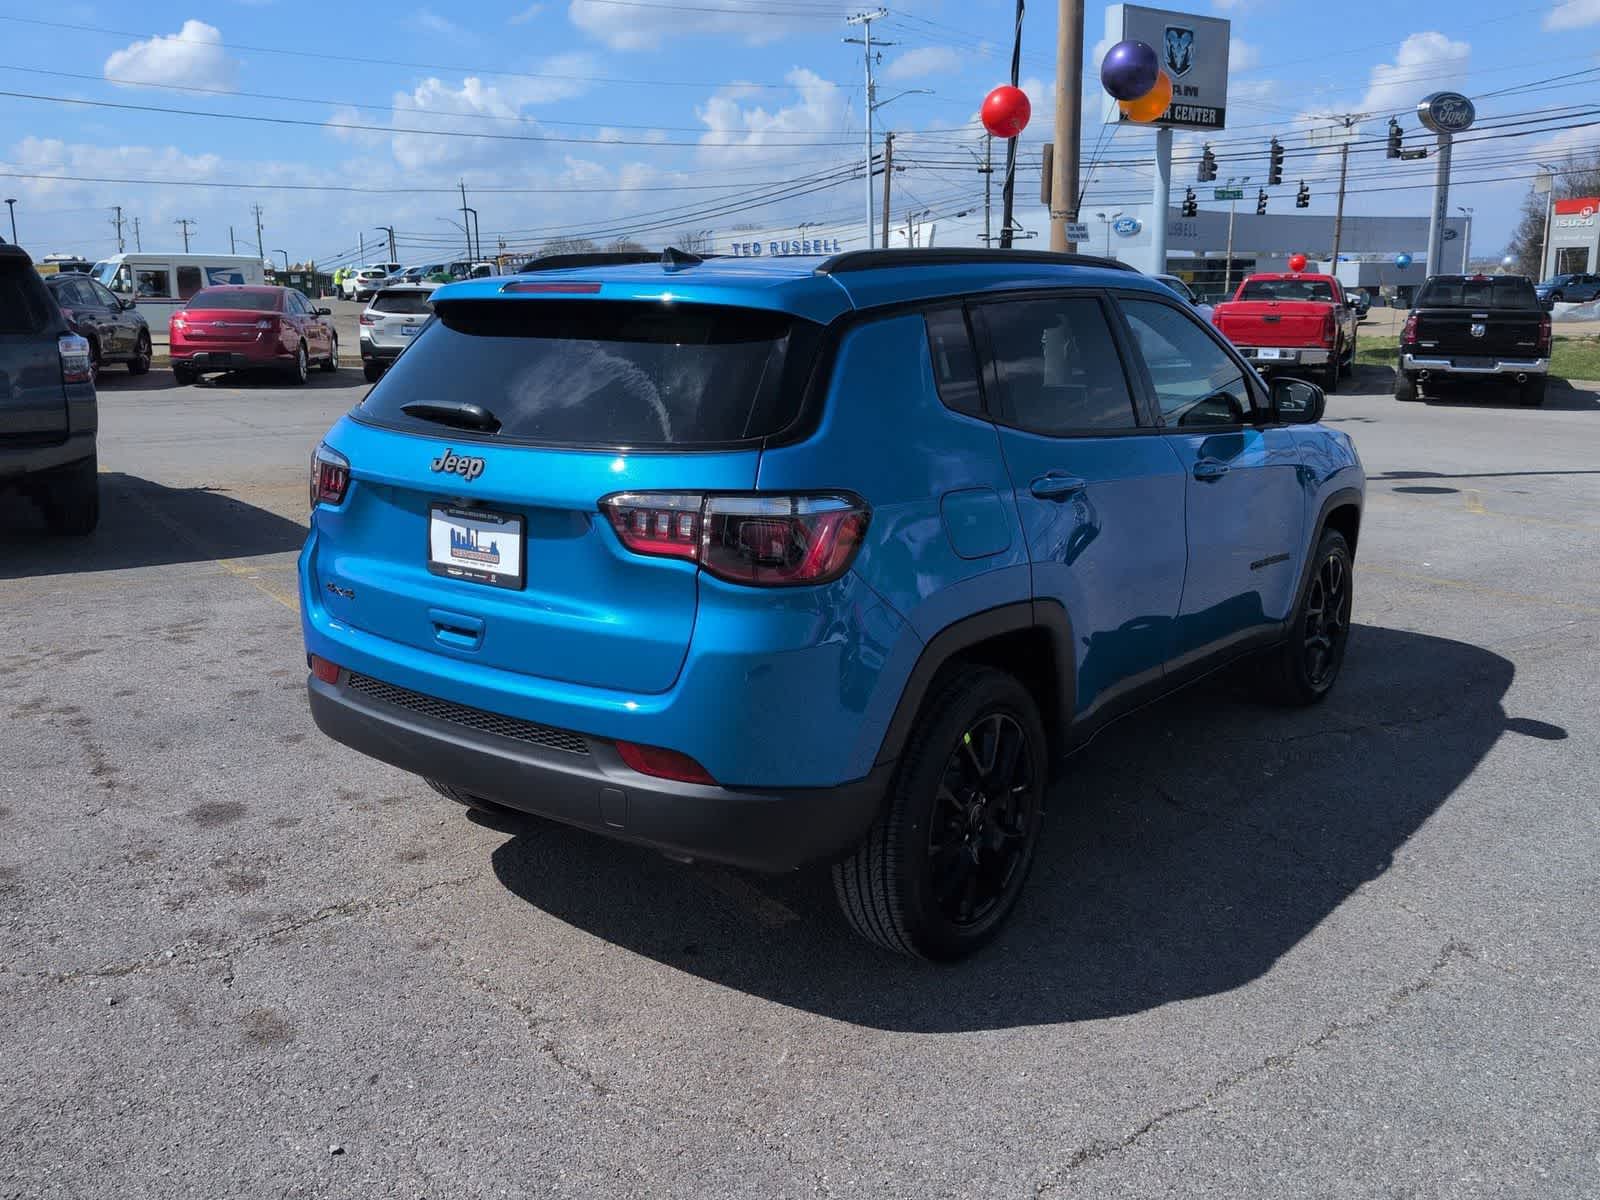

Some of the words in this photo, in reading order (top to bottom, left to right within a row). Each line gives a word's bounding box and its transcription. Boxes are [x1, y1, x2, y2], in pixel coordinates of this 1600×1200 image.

[1172, 84, 1199, 97] AM
[1174, 105, 1217, 124] CENTER
[1438, 99, 1468, 125] Ford
[732, 242, 761, 257] TED
[770, 239, 841, 256] RUSSELL
[431, 447, 485, 482] Jeep
